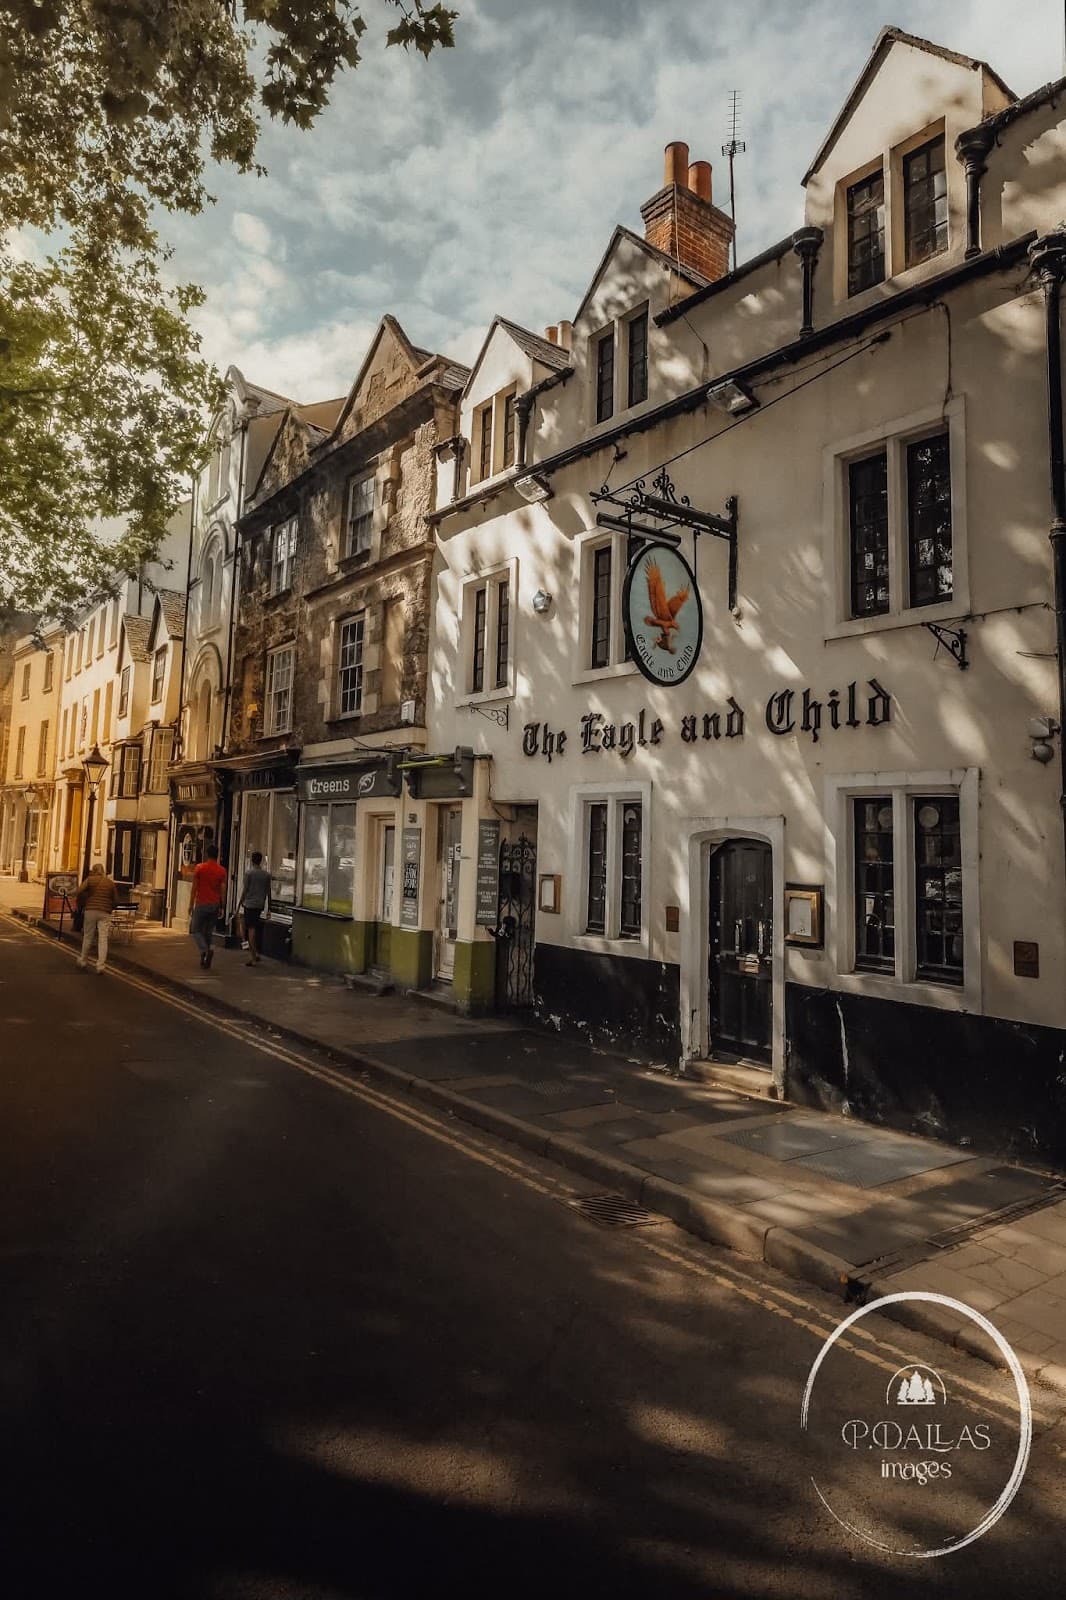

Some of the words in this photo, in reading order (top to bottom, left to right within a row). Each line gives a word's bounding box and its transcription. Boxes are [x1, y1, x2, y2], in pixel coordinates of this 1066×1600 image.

[522, 722, 568, 763] The
[580, 708, 665, 760] Eagle
[680, 696, 744, 743] and
[765, 678, 891, 743] Child
[310, 778, 350, 794] Greens
